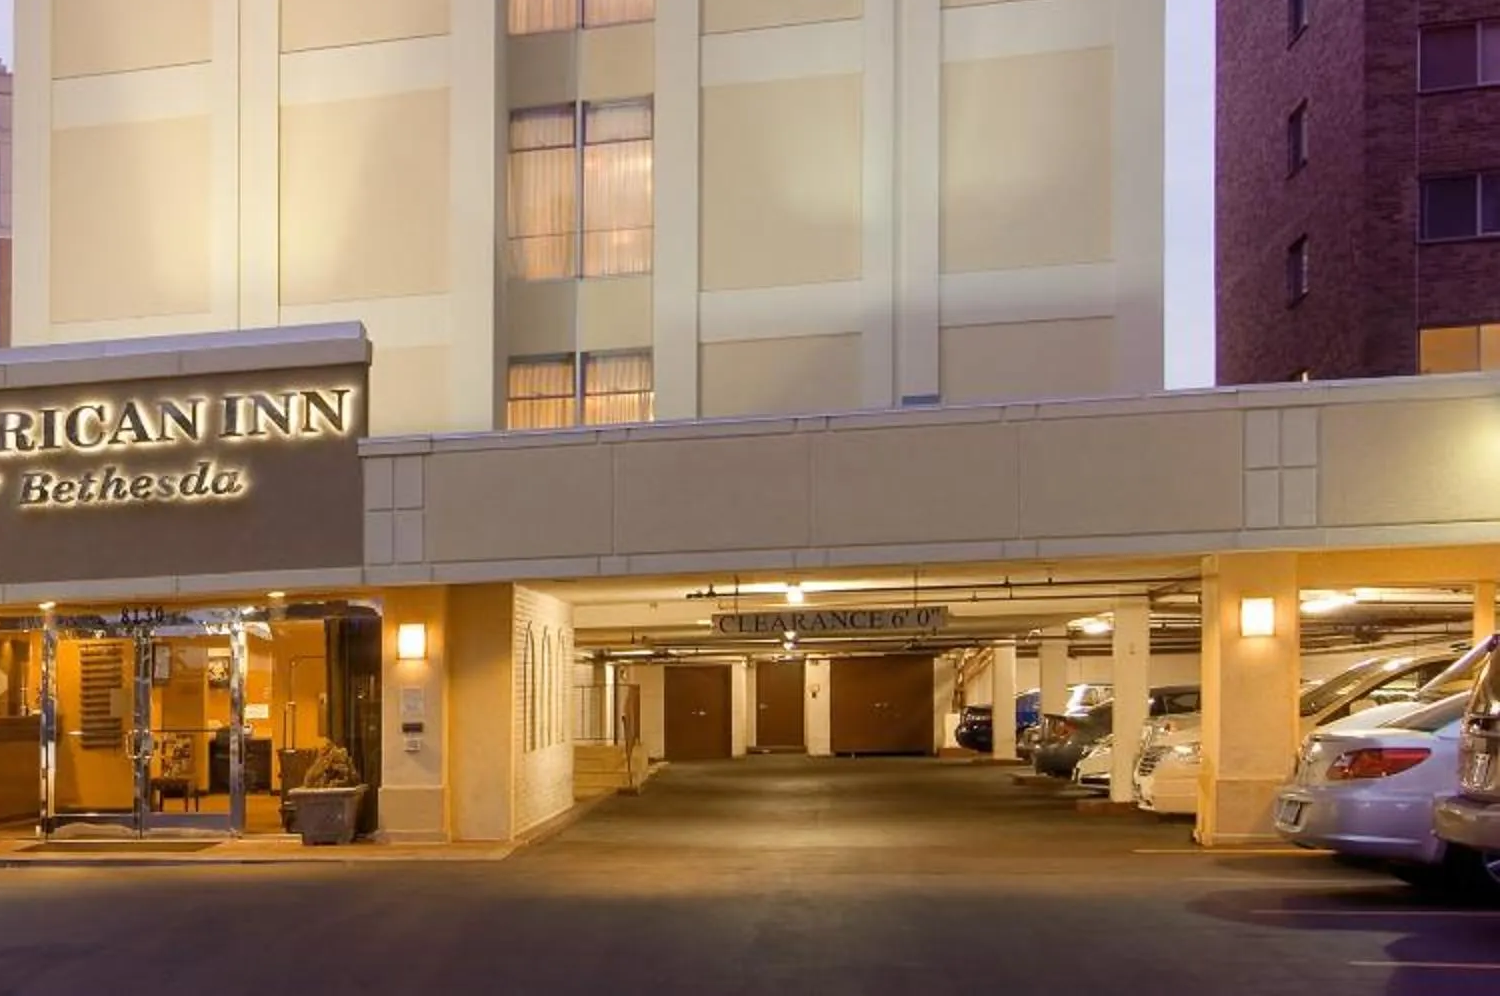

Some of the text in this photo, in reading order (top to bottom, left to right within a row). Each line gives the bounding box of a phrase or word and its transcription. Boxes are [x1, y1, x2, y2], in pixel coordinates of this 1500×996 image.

[218, 388, 352, 438] INN
[19, 460, 245, 506] Bethesda
[719, 610, 883, 633] CLEARANCE
